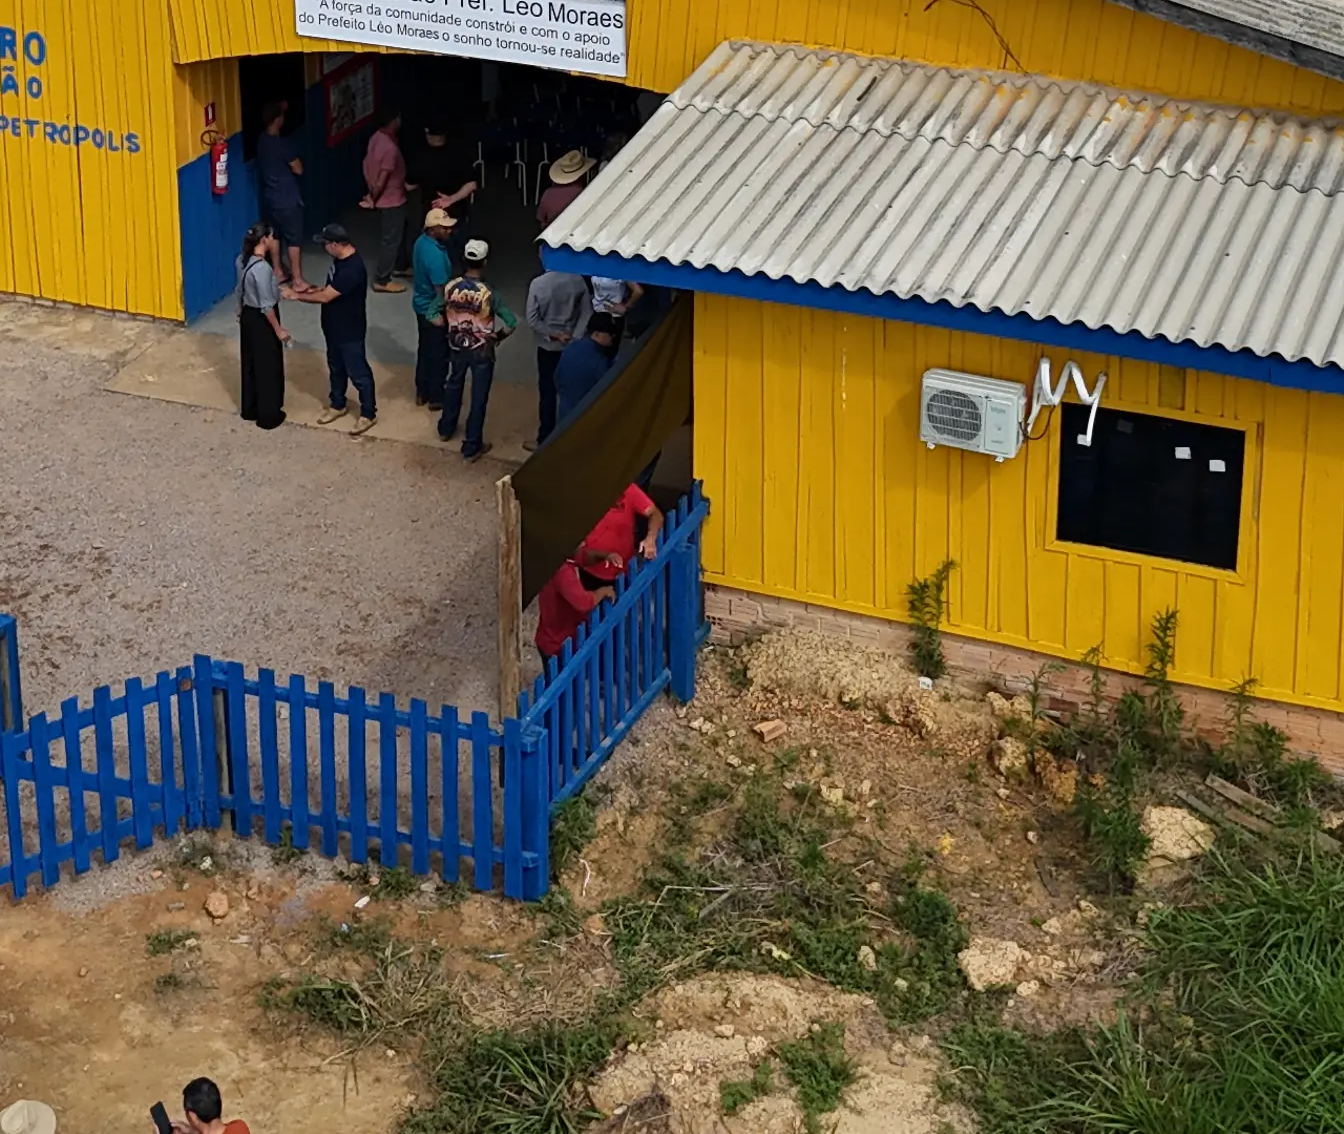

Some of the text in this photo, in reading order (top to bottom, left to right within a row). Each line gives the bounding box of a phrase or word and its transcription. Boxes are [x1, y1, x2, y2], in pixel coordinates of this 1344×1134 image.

[298, 12, 315, 24] do
[318, 13, 366, 31] Prefeito
[369, 20, 393, 34] Léo
[397, 23, 440, 40] Moraes
[442, 32, 450, 42] o
[454, 33, 492, 47] sonho
[496, 37, 556, 56] tornou-se
[332, 0, 362, 16] força
[366, 3, 382, 16] da
[385, 8, 462, 26] comunidade
[466, 18, 516, 33] constrói
[519, 25, 527, 35] e
[531, 26, 559, 39] com
[562, 31, 571, 41] o
[574, 32, 610, 46] apoio
[548, 2, 624, 29] Moraes
